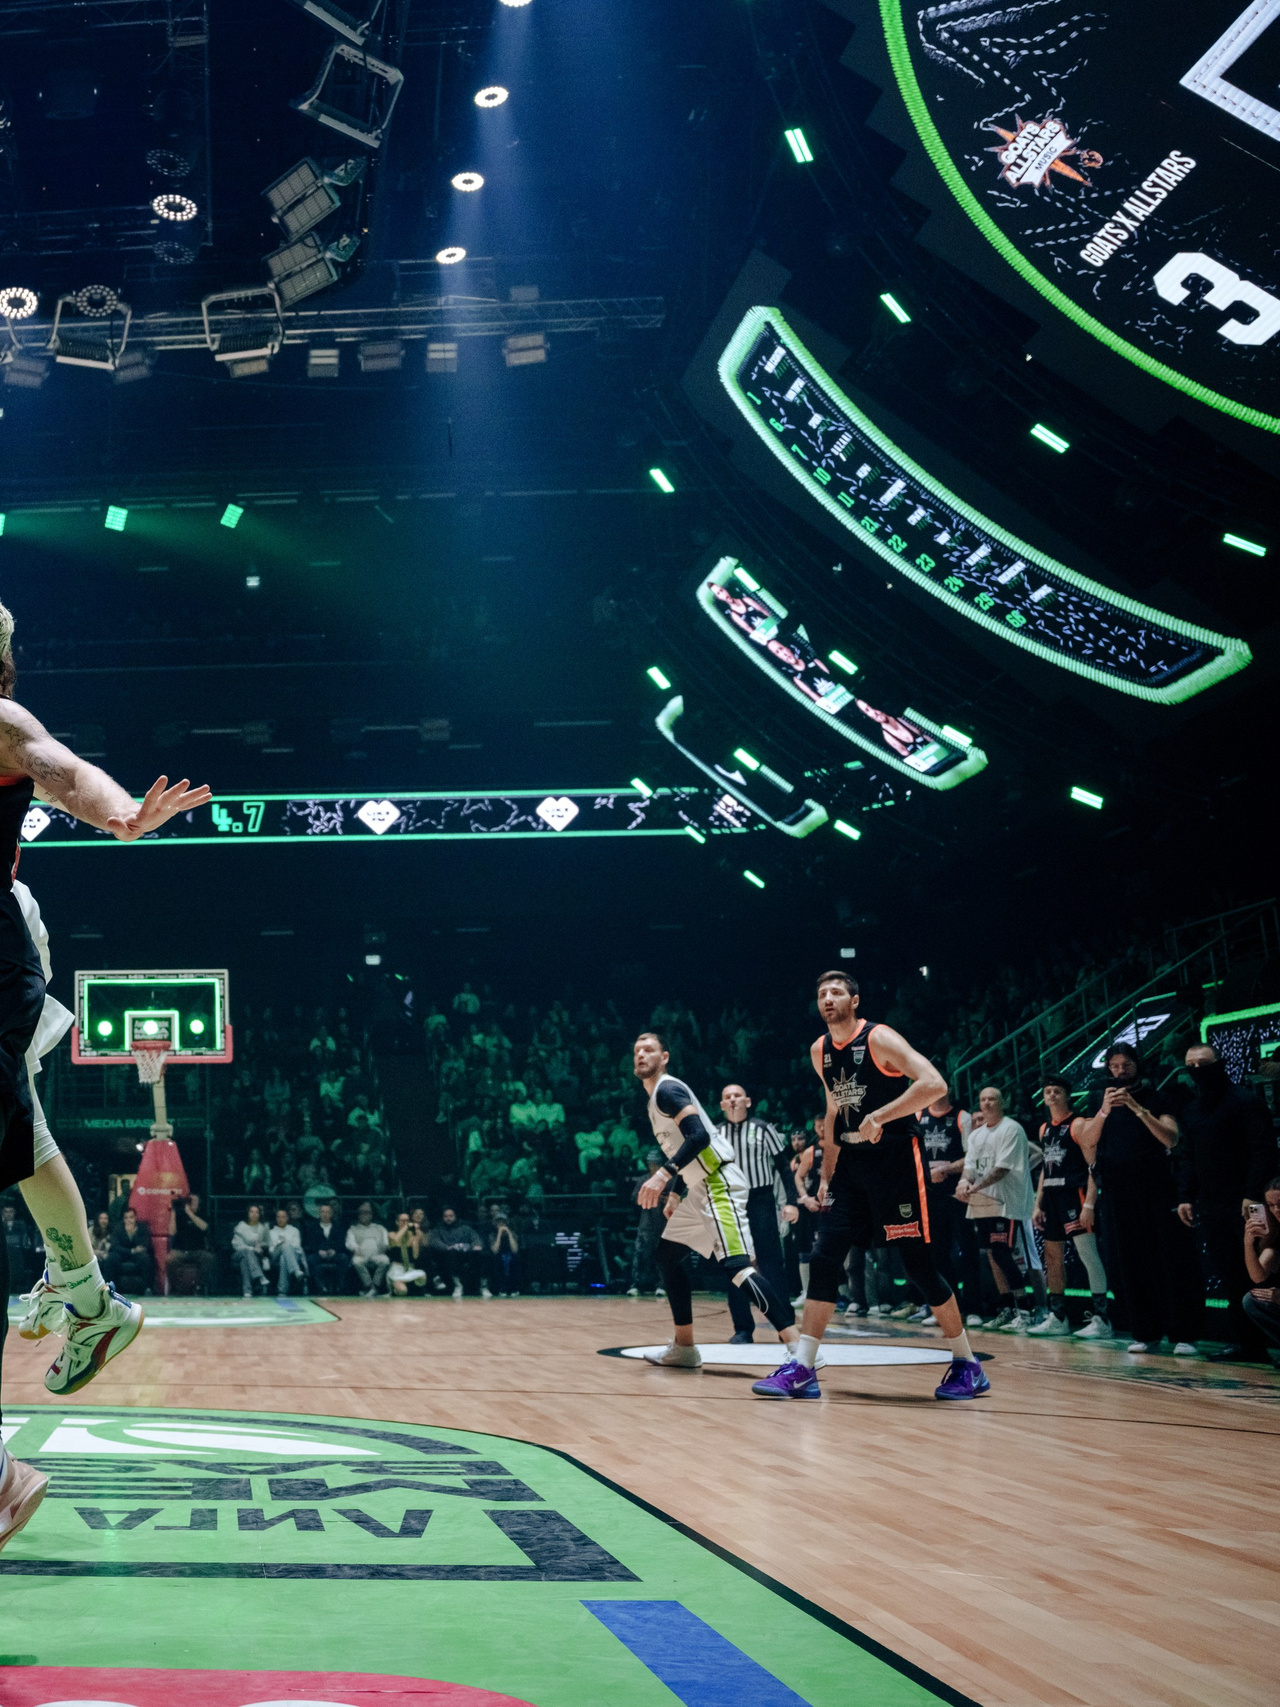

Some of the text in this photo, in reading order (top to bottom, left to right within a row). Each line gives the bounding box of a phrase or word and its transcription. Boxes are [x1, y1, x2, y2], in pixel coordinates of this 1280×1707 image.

[1001, 123, 1041, 164] GOATS
[1005, 121, 1061, 184] ALLSTARS
[1035, 146, 1057, 170] MUSIC
[1079, 150, 1197, 267] GOATS X ALLSTARS
[1152, 252, 1280, 346] 3
[769, 417, 784, 432] 6
[813, 467, 831, 485] 10
[837, 491, 855, 508] 11
[860, 515, 879, 533] 21
[887, 534, 908, 553] 22
[915, 553, 936, 572] 23
[211, 801, 265, 833] 4.7
[84, 1118, 123, 1128] MEDIA
[73, 1506, 434, 1539] ЛИГА
